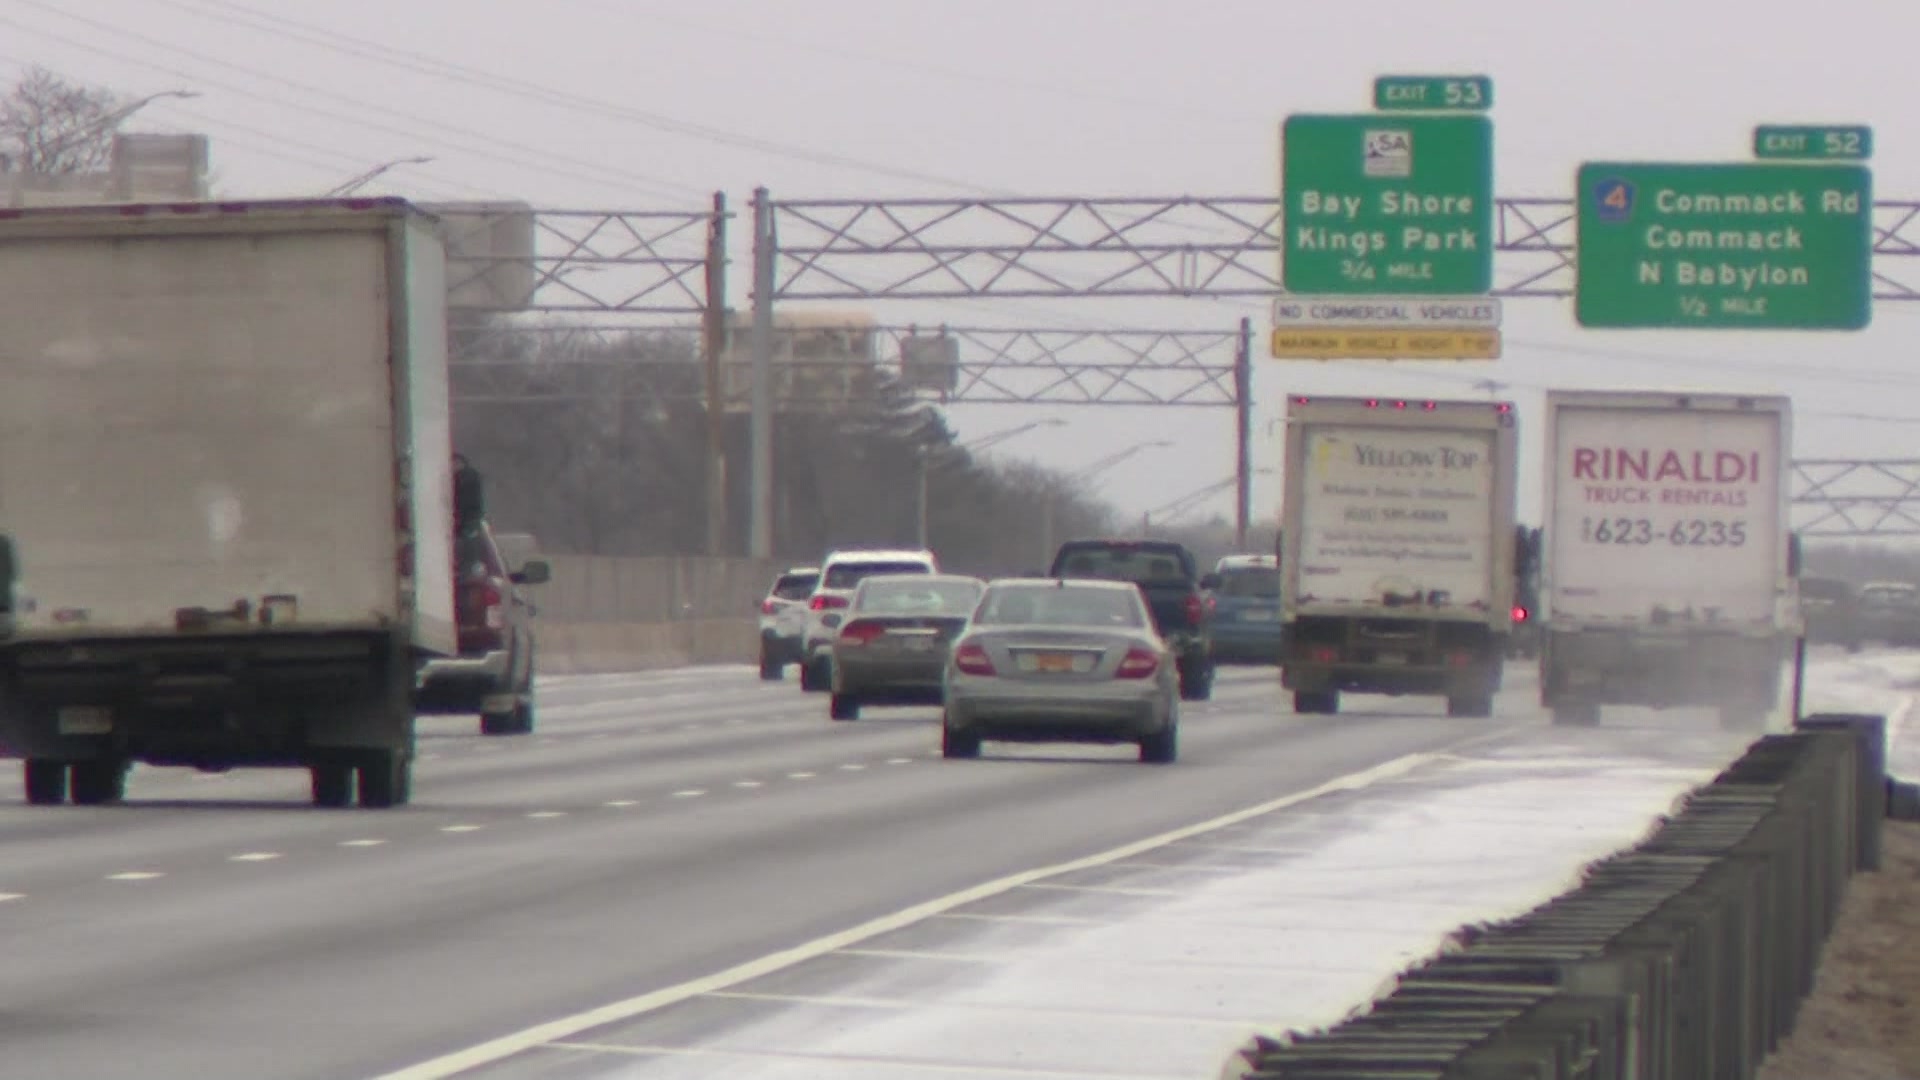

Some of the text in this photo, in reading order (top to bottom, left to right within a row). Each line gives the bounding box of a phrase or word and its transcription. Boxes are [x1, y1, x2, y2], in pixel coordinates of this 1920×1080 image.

[1386, 82, 1482, 104] EXIT 53
[1766, 132, 1860, 153] EXIT 52
[1301, 190, 1473, 219] Bay Shore
[1604, 184, 1626, 209] 4
[1656, 188, 1859, 214] Commack Rd
[1297, 227, 1477, 255] Kings Park
[1645, 224, 1803, 249] Commack
[1387, 262, 1433, 278] MILE
[1638, 261, 1809, 292] N Babylon
[1279, 305, 1494, 320] NO COMMERCIAL VEHICLES
[1721, 298, 1768, 315] MILE
[1572, 447, 1759, 484] RINALDI
[1584, 486, 1748, 507] TRUCK RENTALS
[1594, 517, 1747, 547] 623-6235
